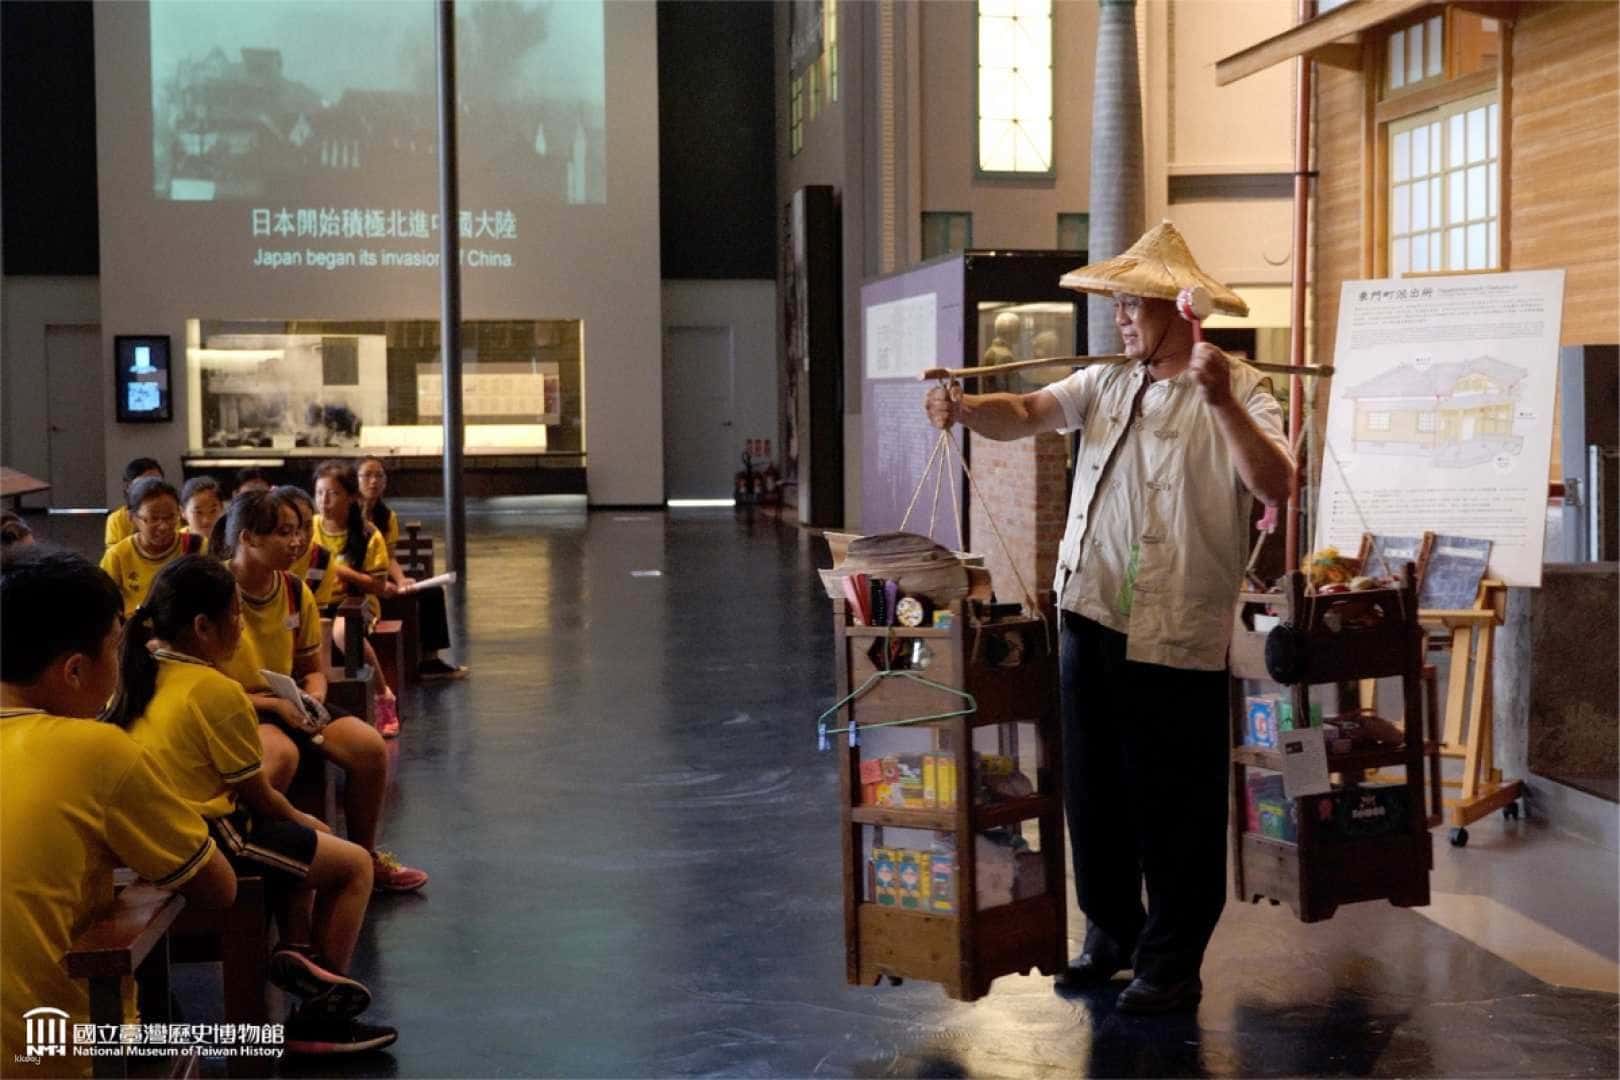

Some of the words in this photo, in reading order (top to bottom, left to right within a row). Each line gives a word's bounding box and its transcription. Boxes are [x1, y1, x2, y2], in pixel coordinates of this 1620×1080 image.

[252, 208, 517, 239] 日本開始積極北進國大陸
[254, 248, 301, 270] Japan
[306, 248, 355, 270] began
[359, 249, 377, 266] its
